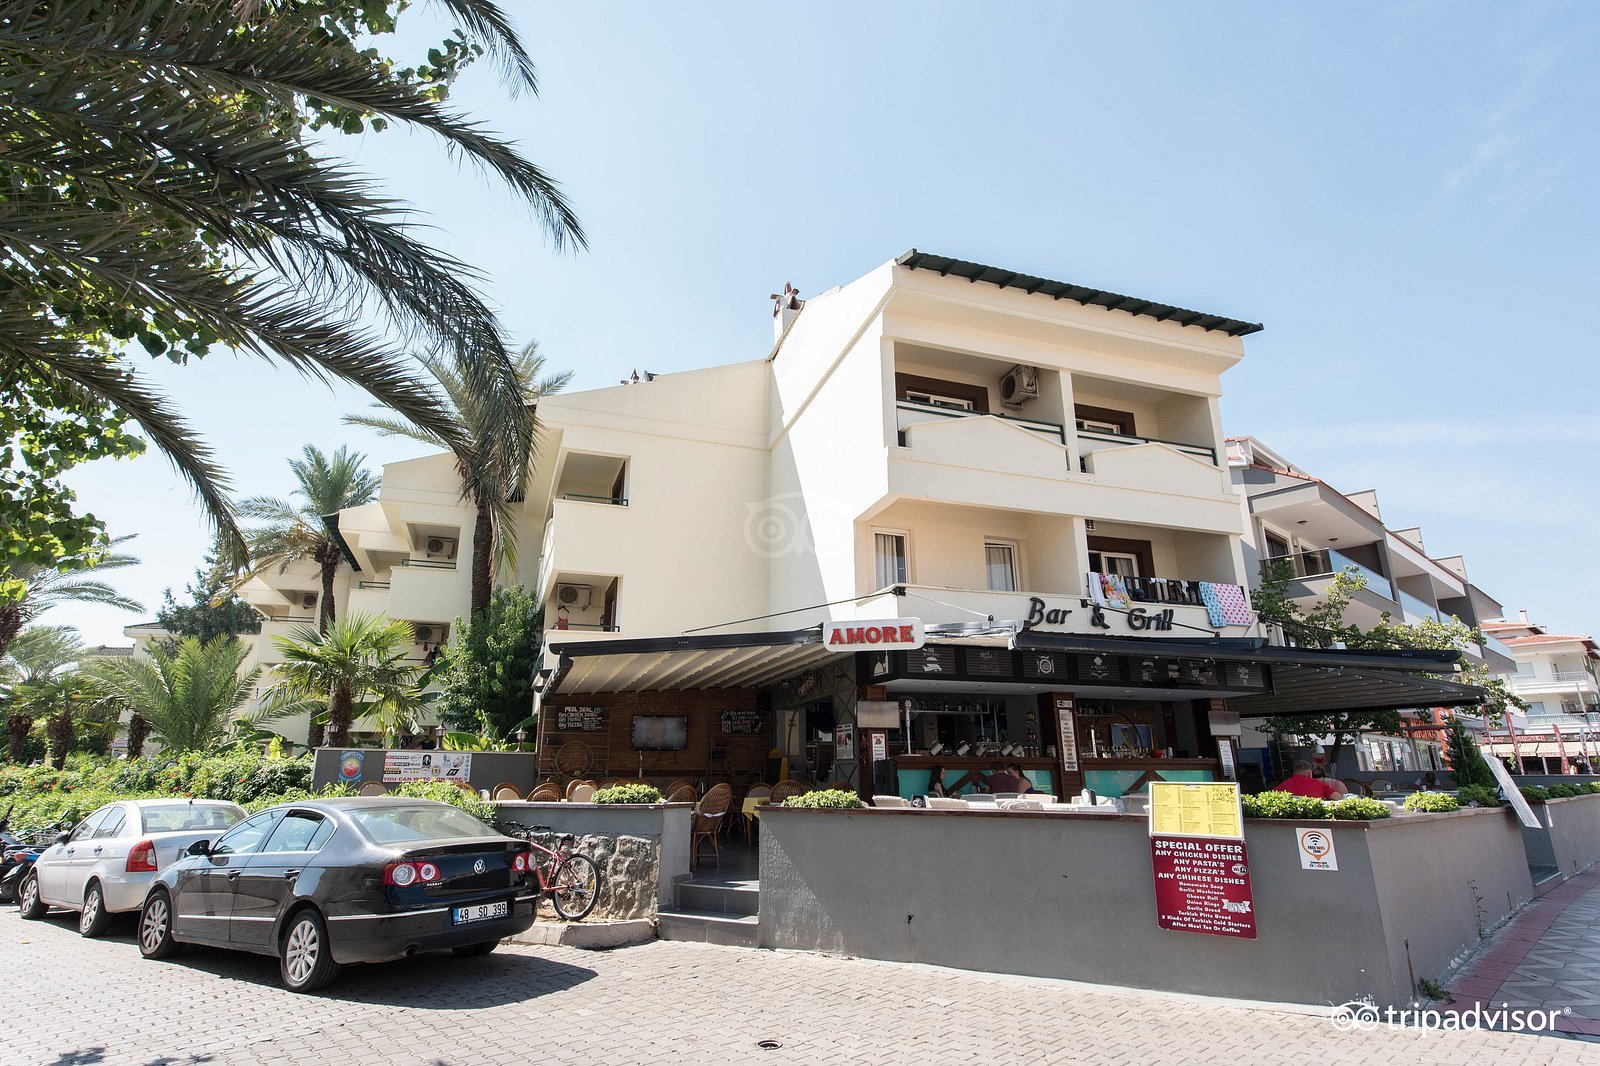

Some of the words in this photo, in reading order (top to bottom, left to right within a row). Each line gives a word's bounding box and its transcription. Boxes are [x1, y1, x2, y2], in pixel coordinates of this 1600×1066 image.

[1027, 597, 1072, 627] Bar
[1091, 605, 1111, 629] &
[1128, 607, 1174, 631] Grill
[828, 624, 915, 645] AMORE
[1155, 840, 1202, 851] SPECIAL
[1205, 843, 1243, 854] OFFER
[1173, 851, 1210, 859] CHICKEN
[1192, 860, 1225, 868] PASTA'S
[1194, 867, 1225, 875] PIZZA'S
[1176, 874, 1212, 882] CHINESE
[1214, 877, 1245, 885] DISHES
[1178, 881, 1209, 889] Homemade
[460, 908, 469, 920] 48
[492, 903, 506, 915] 399
